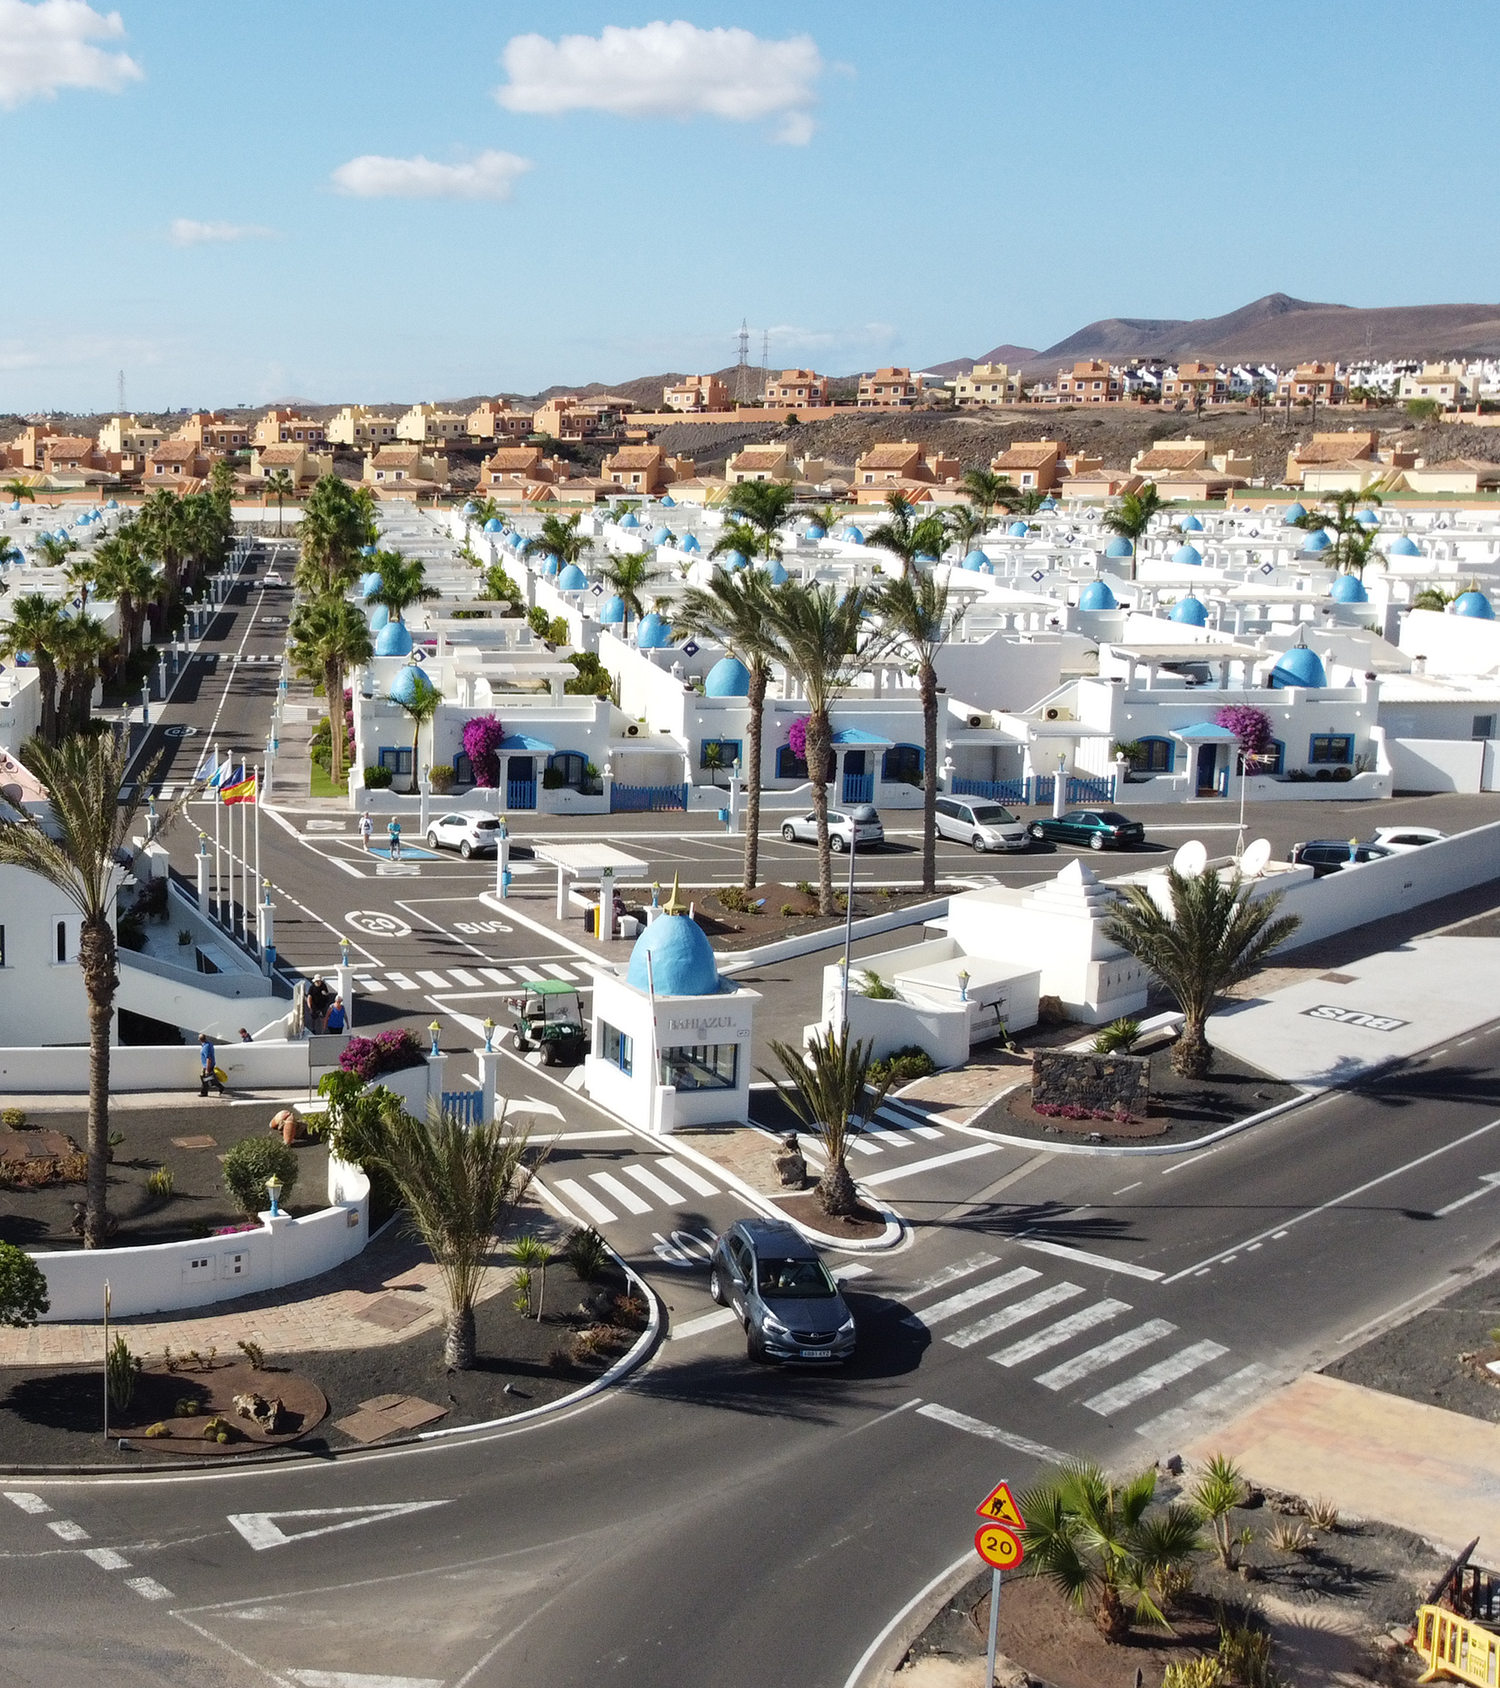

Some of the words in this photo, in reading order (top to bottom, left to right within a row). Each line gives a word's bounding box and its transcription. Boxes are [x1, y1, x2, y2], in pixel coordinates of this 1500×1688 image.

[361, 918, 396, 930] 20
[453, 920, 514, 934] BUS
[668, 1017, 737, 1030] BAHIAZUL
[1310, 1007, 1402, 1030] BUS
[986, 1536, 1012, 1555] 20
